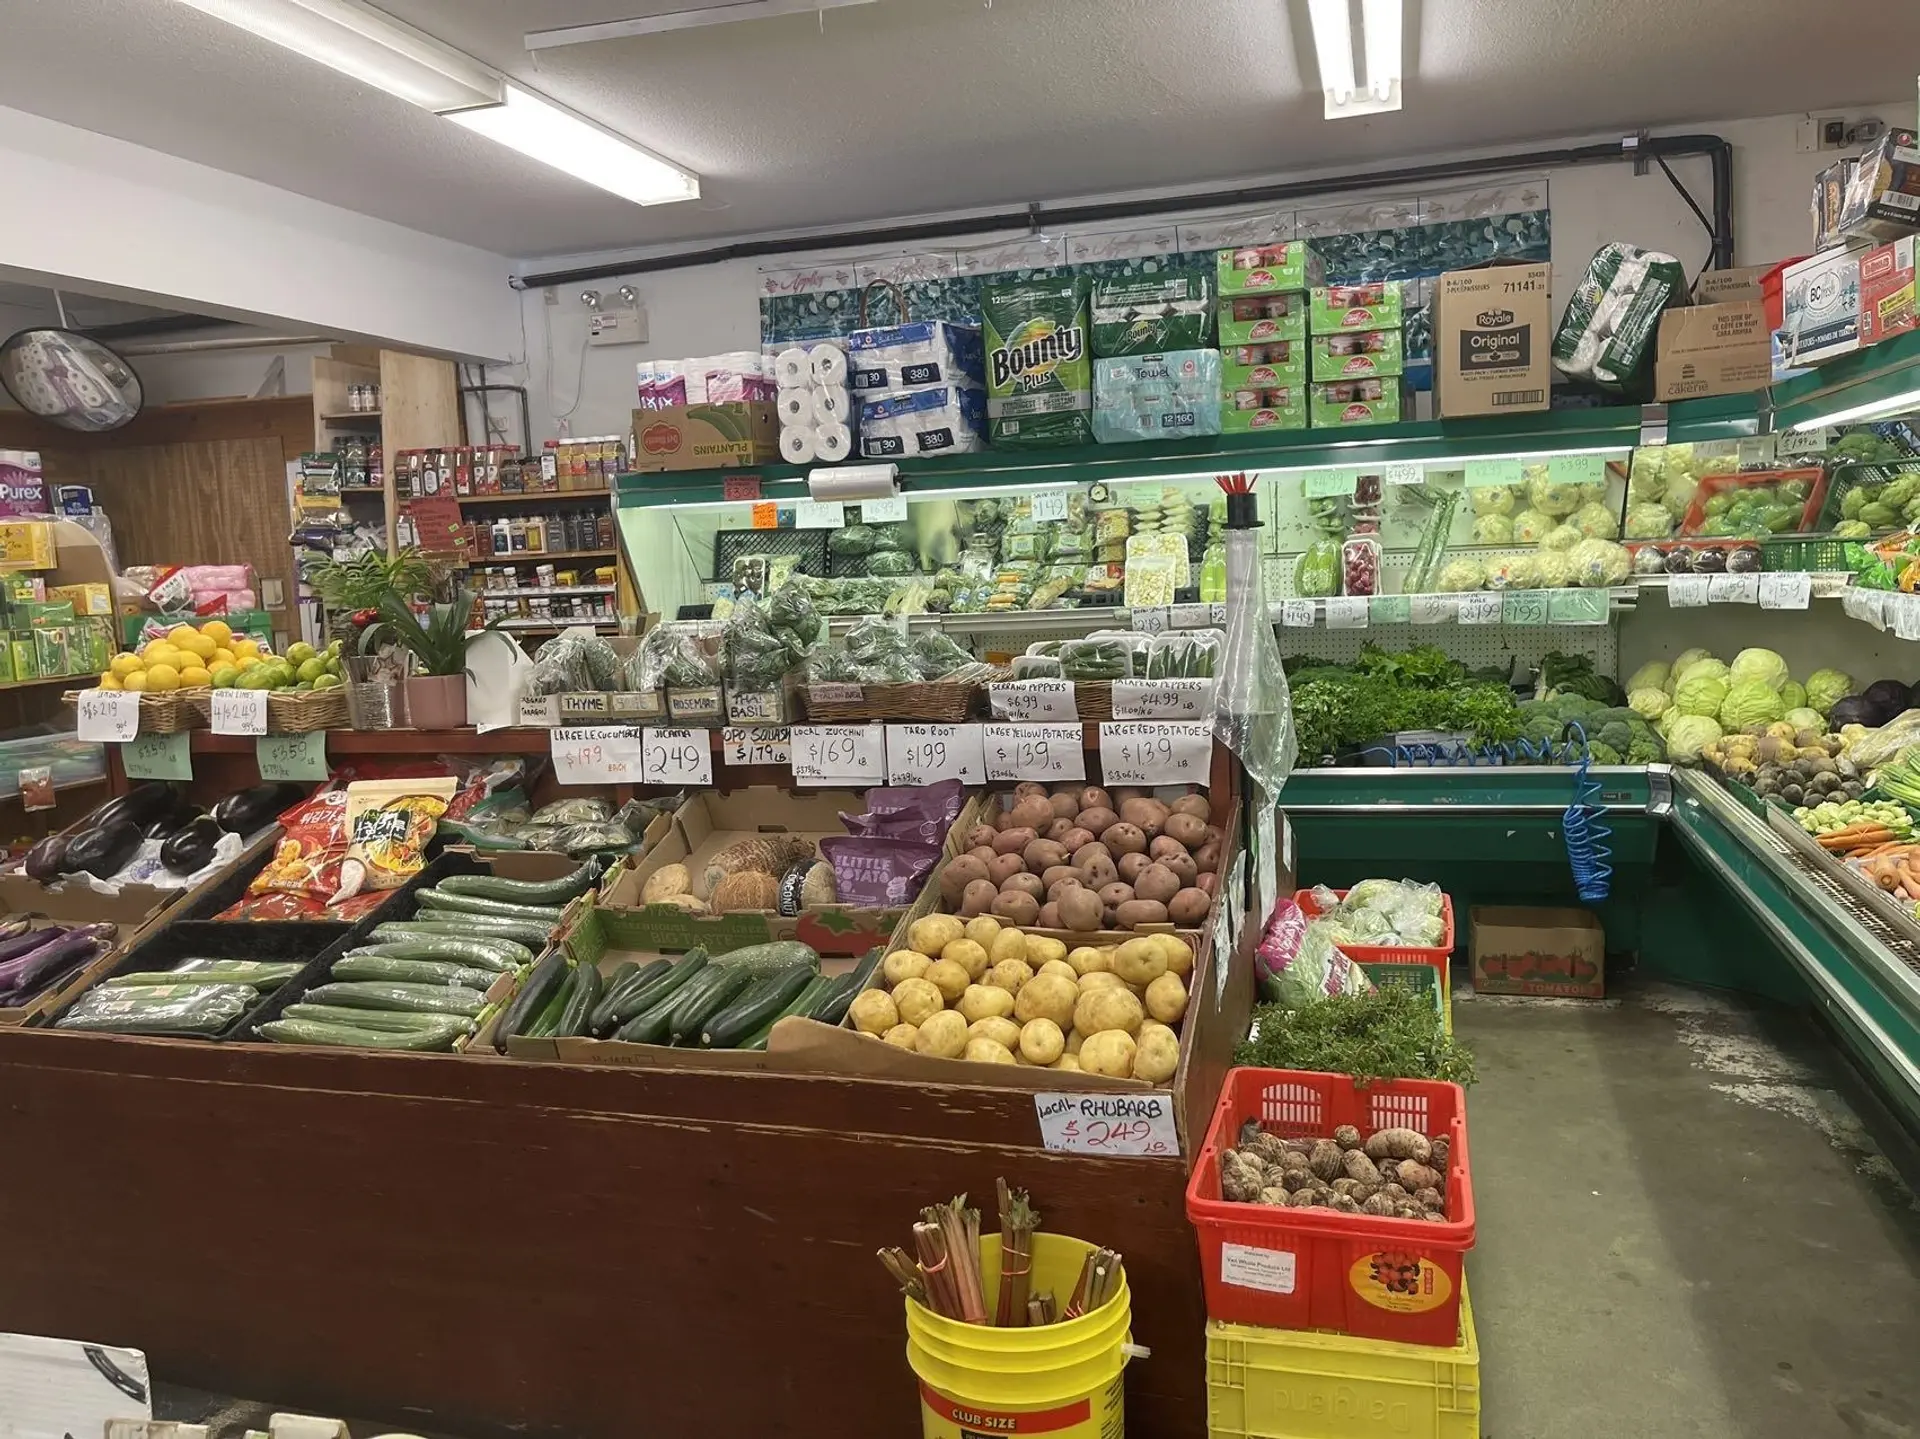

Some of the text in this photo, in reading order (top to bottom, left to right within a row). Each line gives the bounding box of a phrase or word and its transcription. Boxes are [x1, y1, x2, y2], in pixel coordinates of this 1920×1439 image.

[1503, 281, 1535, 293] 71141
[1479, 313, 1512, 326] Royale
[1125, 321, 1158, 344] Bounty
[1470, 332, 1520, 350] Original
[990, 325, 1084, 390] Bounty
[868, 367, 930, 381] 30 380
[1135, 366, 1170, 379] Towel
[1022, 371, 1052, 392] Plus
[1163, 413, 1194, 423] 12 160
[882, 432, 944, 449] 30 380
[693, 443, 748, 456] PLANTAINS
[0, 484, 42, 500] Purex
[565, 698, 605, 711] THYME
[730, 704, 770, 718] BASIL
[554, 730, 583, 741] LARGE
[653, 729, 692, 739] JICAMA
[724, 727, 746, 742] OPO
[793, 727, 865, 737] LOCAL ZUCCHINI
[903, 725, 957, 737] TARO ROOT
[985, 728, 1010, 738] LARGE
[1042, 728, 1082, 741] POTATOES
[1103, 724, 1211, 737] LARGE RED POTATOES
[842, 855, 893, 870] LITTLE
[835, 866, 890, 884] POTATO
[651, 932, 736, 945] BIG TASTE
[1039, 1097, 1163, 1119] LOCAL RHUBARB
[1256, 1262, 1280, 1270] Produce
[952, 1408, 1016, 1429] CLUB SIZE
